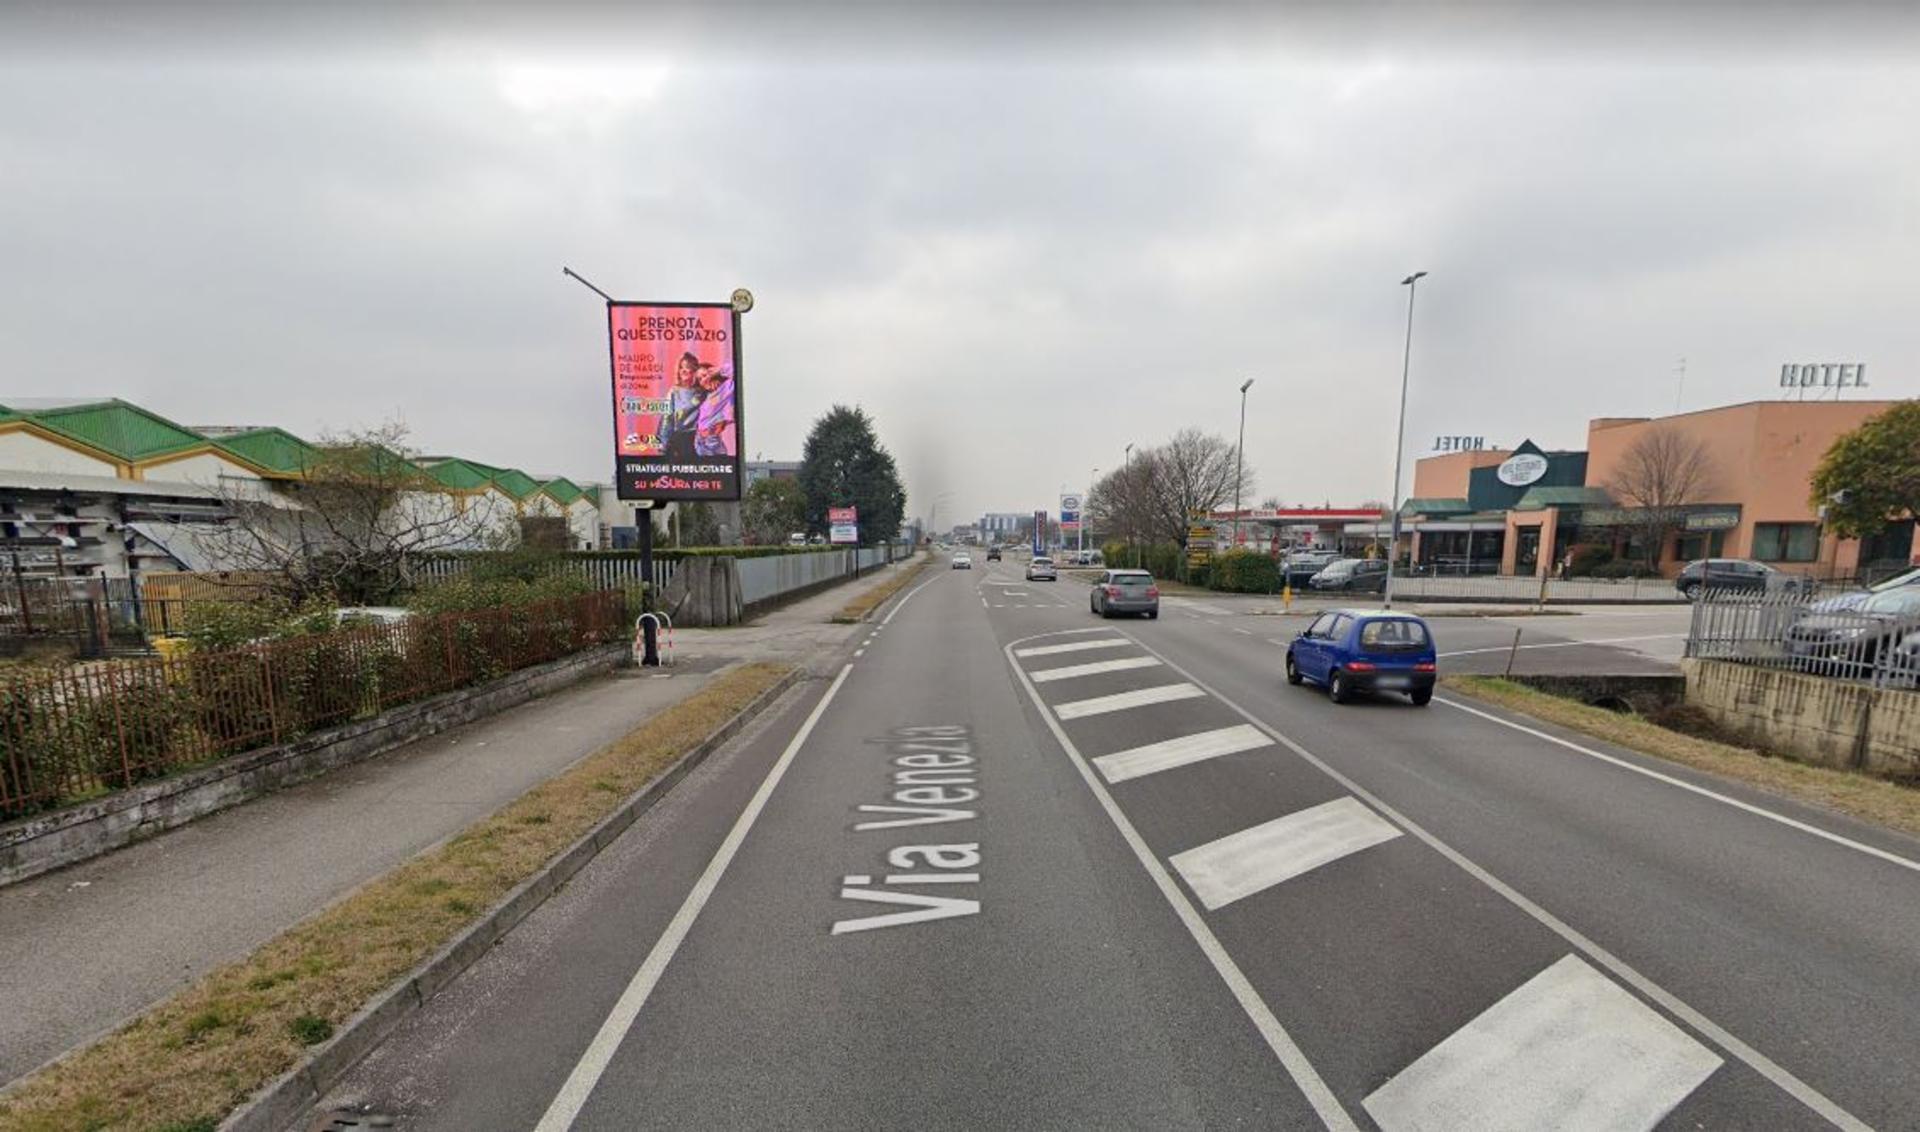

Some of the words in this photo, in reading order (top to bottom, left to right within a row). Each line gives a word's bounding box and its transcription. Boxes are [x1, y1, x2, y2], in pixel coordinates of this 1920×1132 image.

[639, 317, 704, 329] PRENOTA
[618, 329, 675, 341] QUESTO
[678, 329, 727, 342] SPAZIO
[618, 353, 655, 362] MAURO
[619, 364, 631, 373] DE
[1780, 363, 1870, 387] HOTEL
[625, 464, 670, 473] STRATEGIE
[672, 464, 733, 474] PUBBLICITARIE
[634, 481, 647, 489] SU
[692, 481, 709, 489] PER
[711, 481, 721, 489] TE
